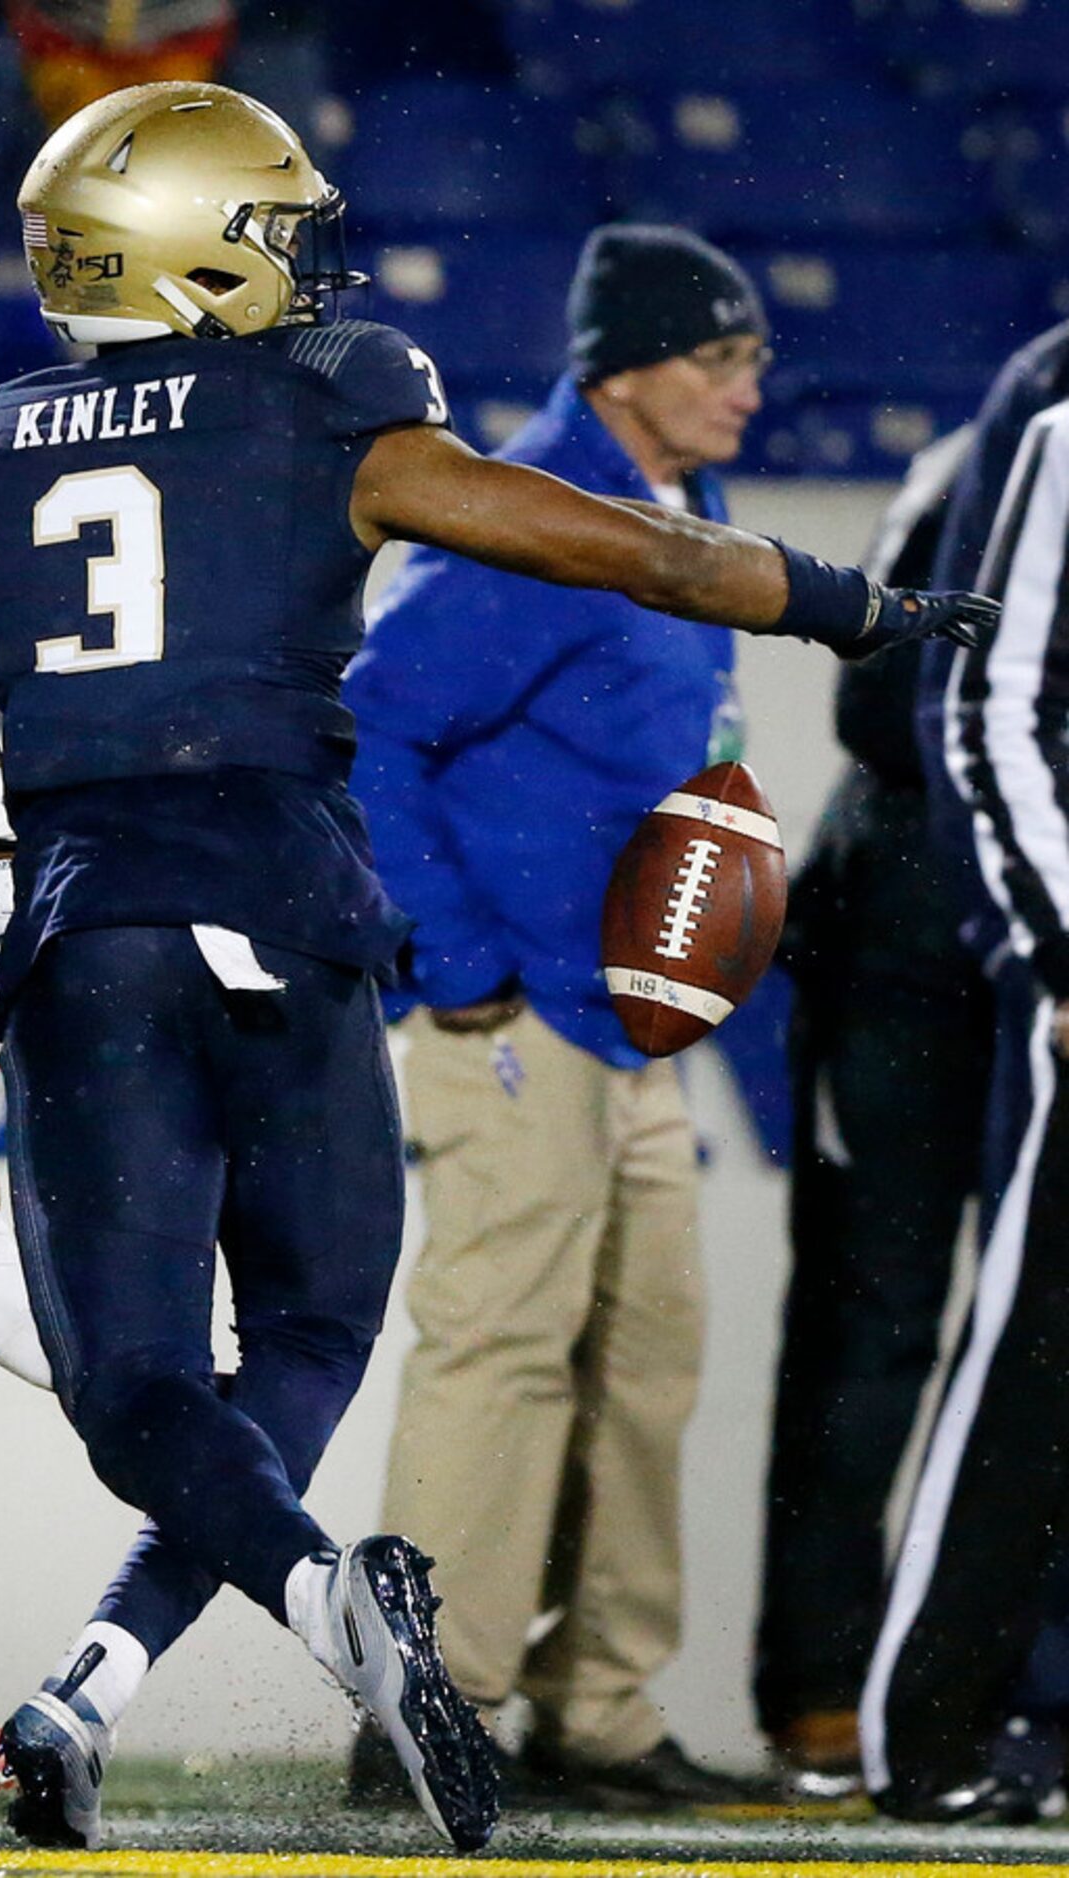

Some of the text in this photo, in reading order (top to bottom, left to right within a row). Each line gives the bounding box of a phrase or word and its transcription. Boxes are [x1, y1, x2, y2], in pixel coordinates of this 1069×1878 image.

[13, 374, 196, 449] KINLEY
[406, 347, 447, 424] 3
[33, 464, 165, 674] 3
